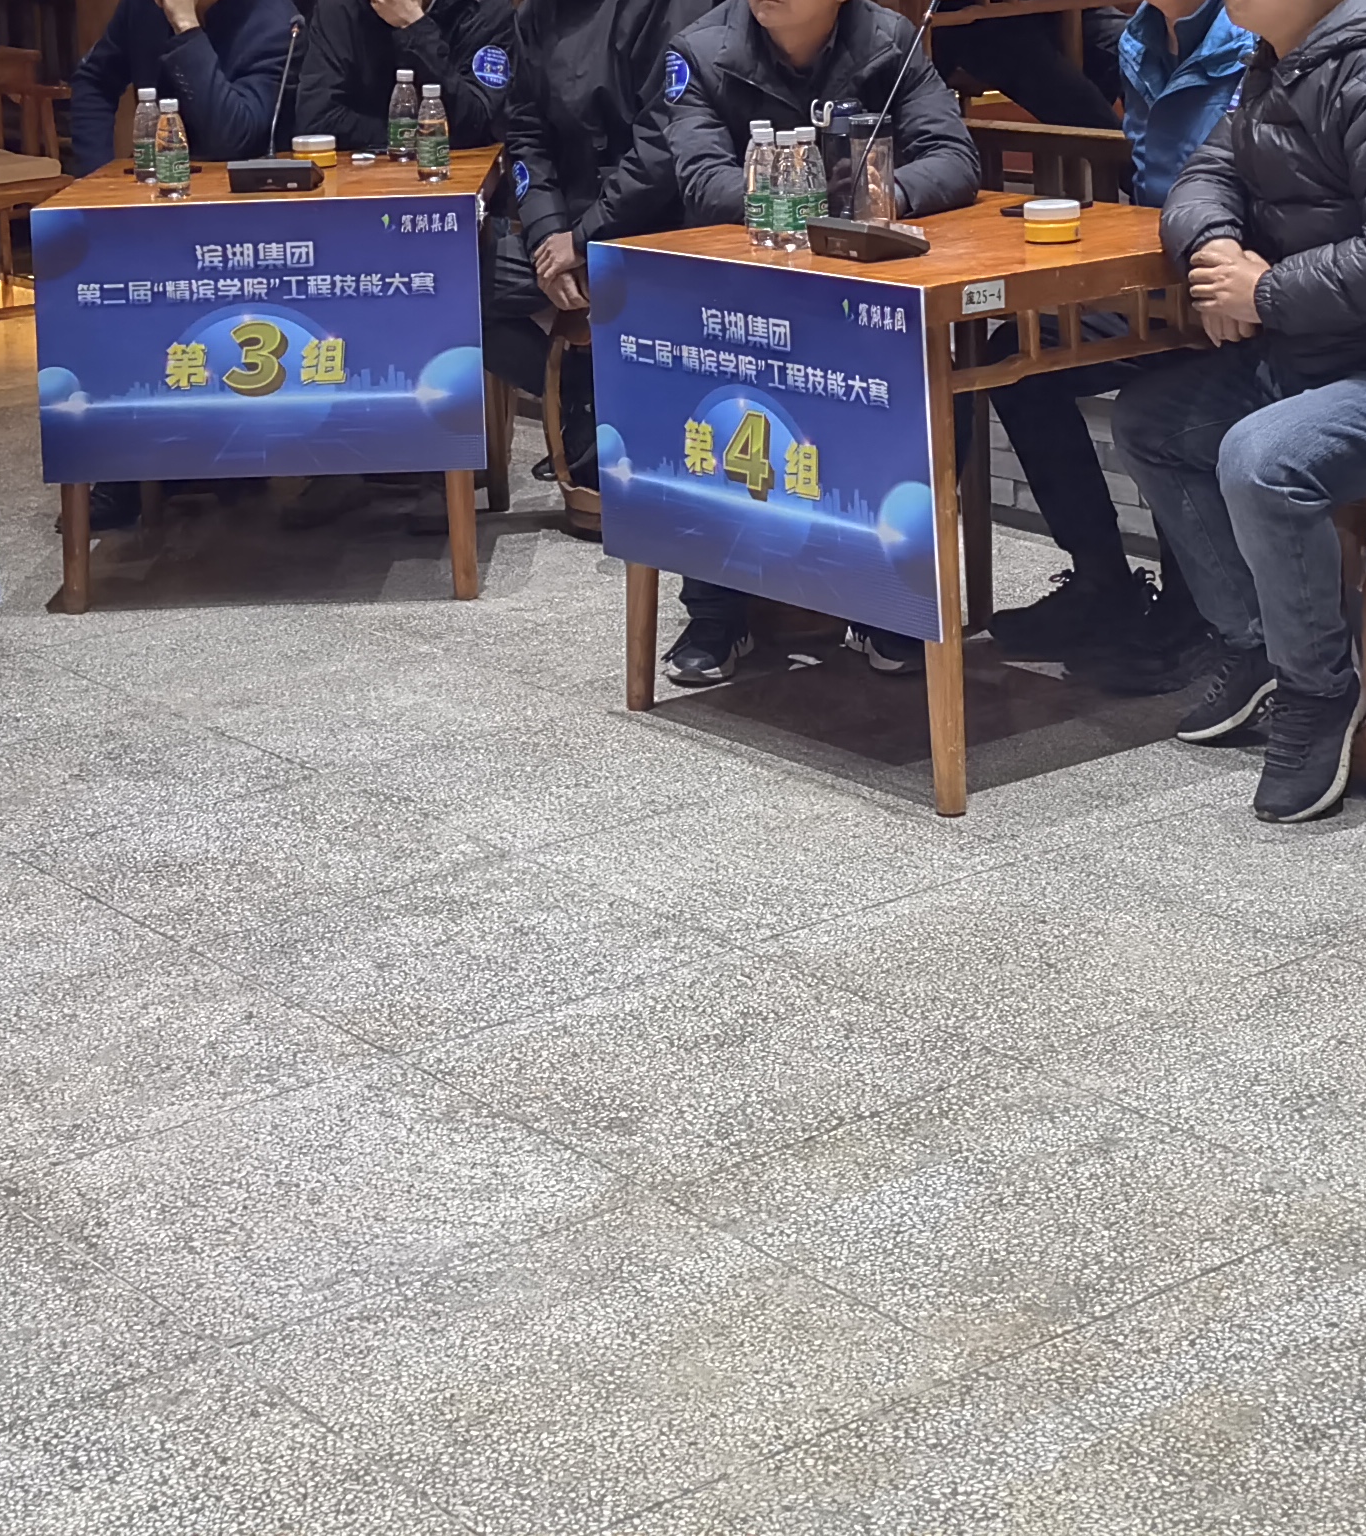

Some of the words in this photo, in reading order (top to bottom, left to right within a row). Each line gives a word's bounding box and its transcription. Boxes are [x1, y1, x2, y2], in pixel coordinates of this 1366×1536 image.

[195, 241, 315, 270] 滨湖集团
[165, 320, 347, 397] 第3组
[701, 306, 792, 352] 滨湖集团
[683, 410, 821, 502] 第4组
